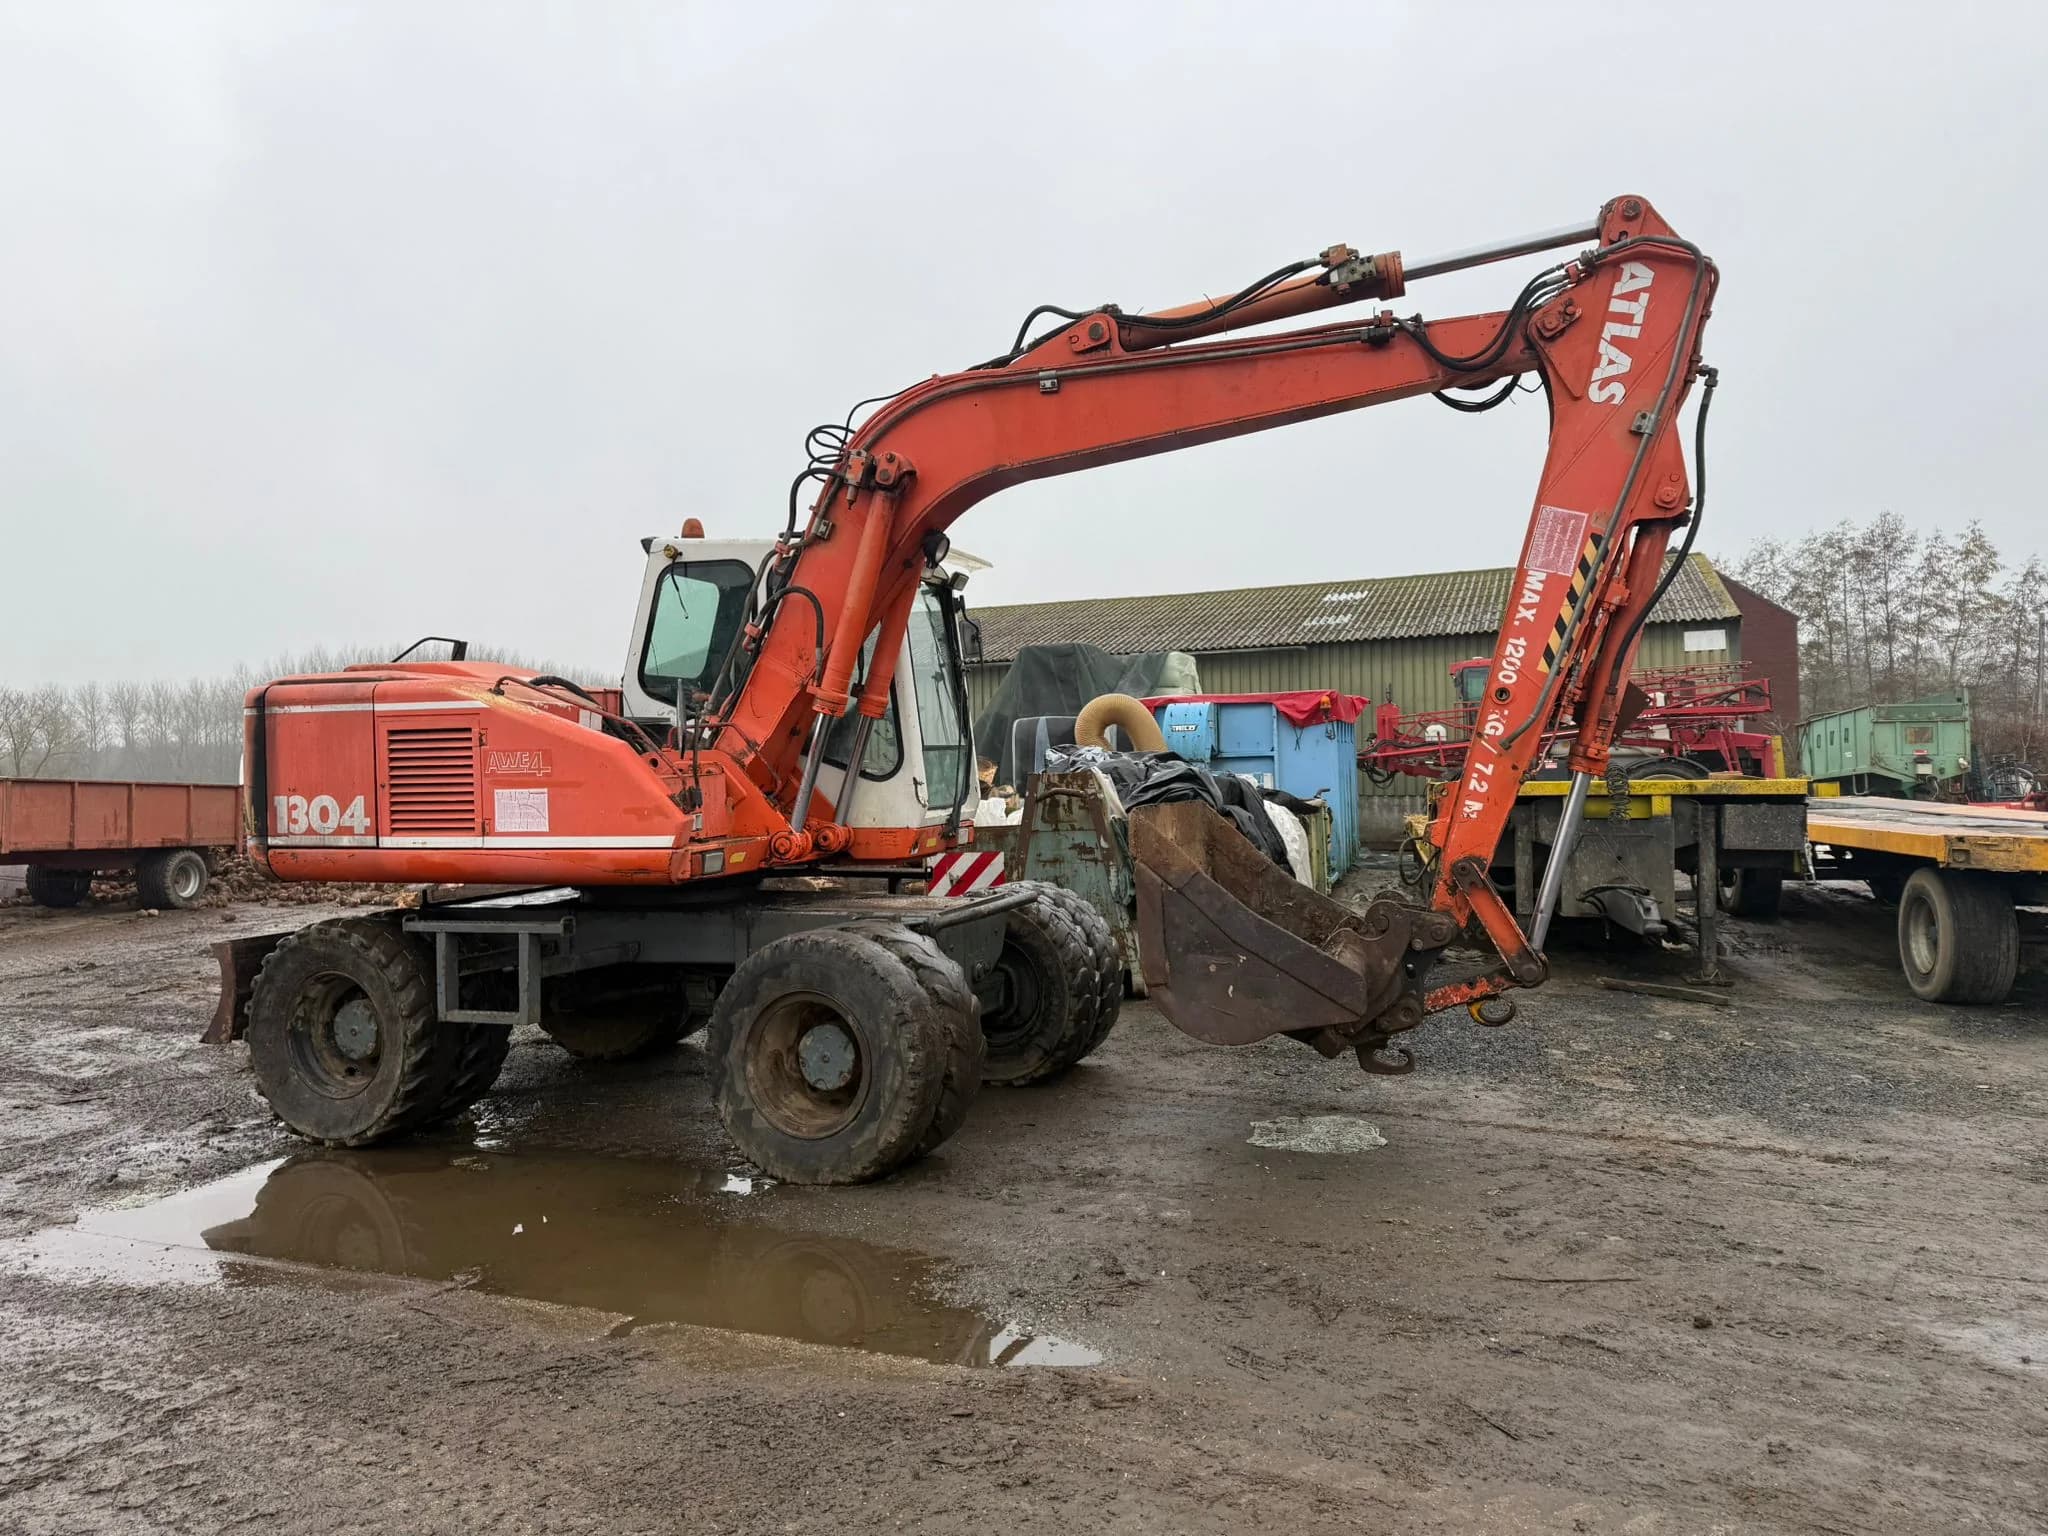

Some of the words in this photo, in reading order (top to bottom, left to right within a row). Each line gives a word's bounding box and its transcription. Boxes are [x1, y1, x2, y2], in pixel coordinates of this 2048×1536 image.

[1588, 262, 1654, 405] ATLAS
[1513, 570, 1546, 626] MAX.
[1498, 637, 1527, 685] 1200
[1469, 763, 1494, 793] 7.2
[274, 795, 371, 834] 1304
